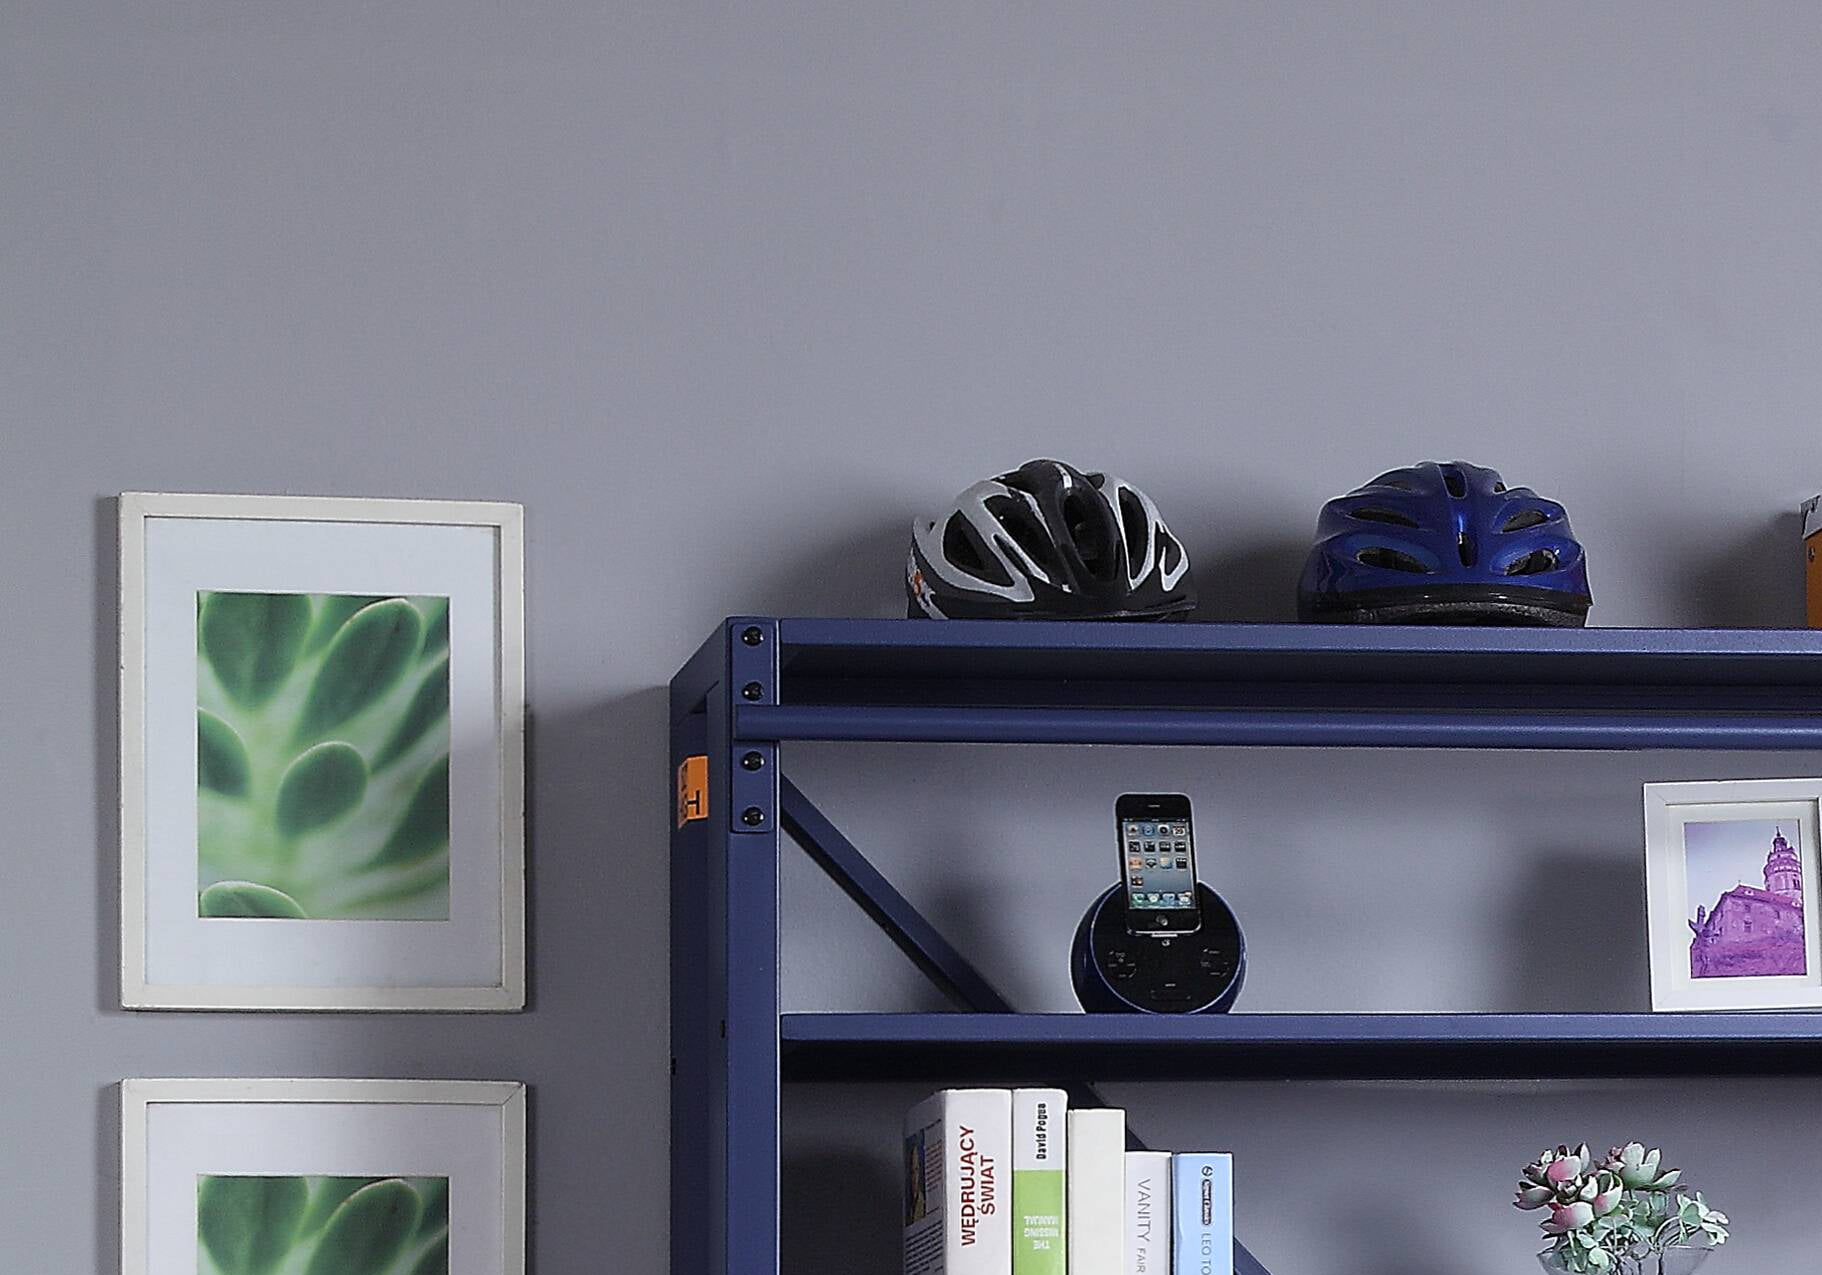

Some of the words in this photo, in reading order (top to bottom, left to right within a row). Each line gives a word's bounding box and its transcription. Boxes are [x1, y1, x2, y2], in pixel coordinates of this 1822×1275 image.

[1035, 1103, 1048, 1132] Pogue
[1035, 1133, 1047, 1160] David
[959, 1125, 979, 1247] WĘDRUJĄCY
[977, 1155, 996, 1215] ŚWIAT
[1137, 1178, 1151, 1242] VANITY
[1201, 1233, 1212, 1256] LEO
[1136, 1247, 1146, 1273] FAIR
